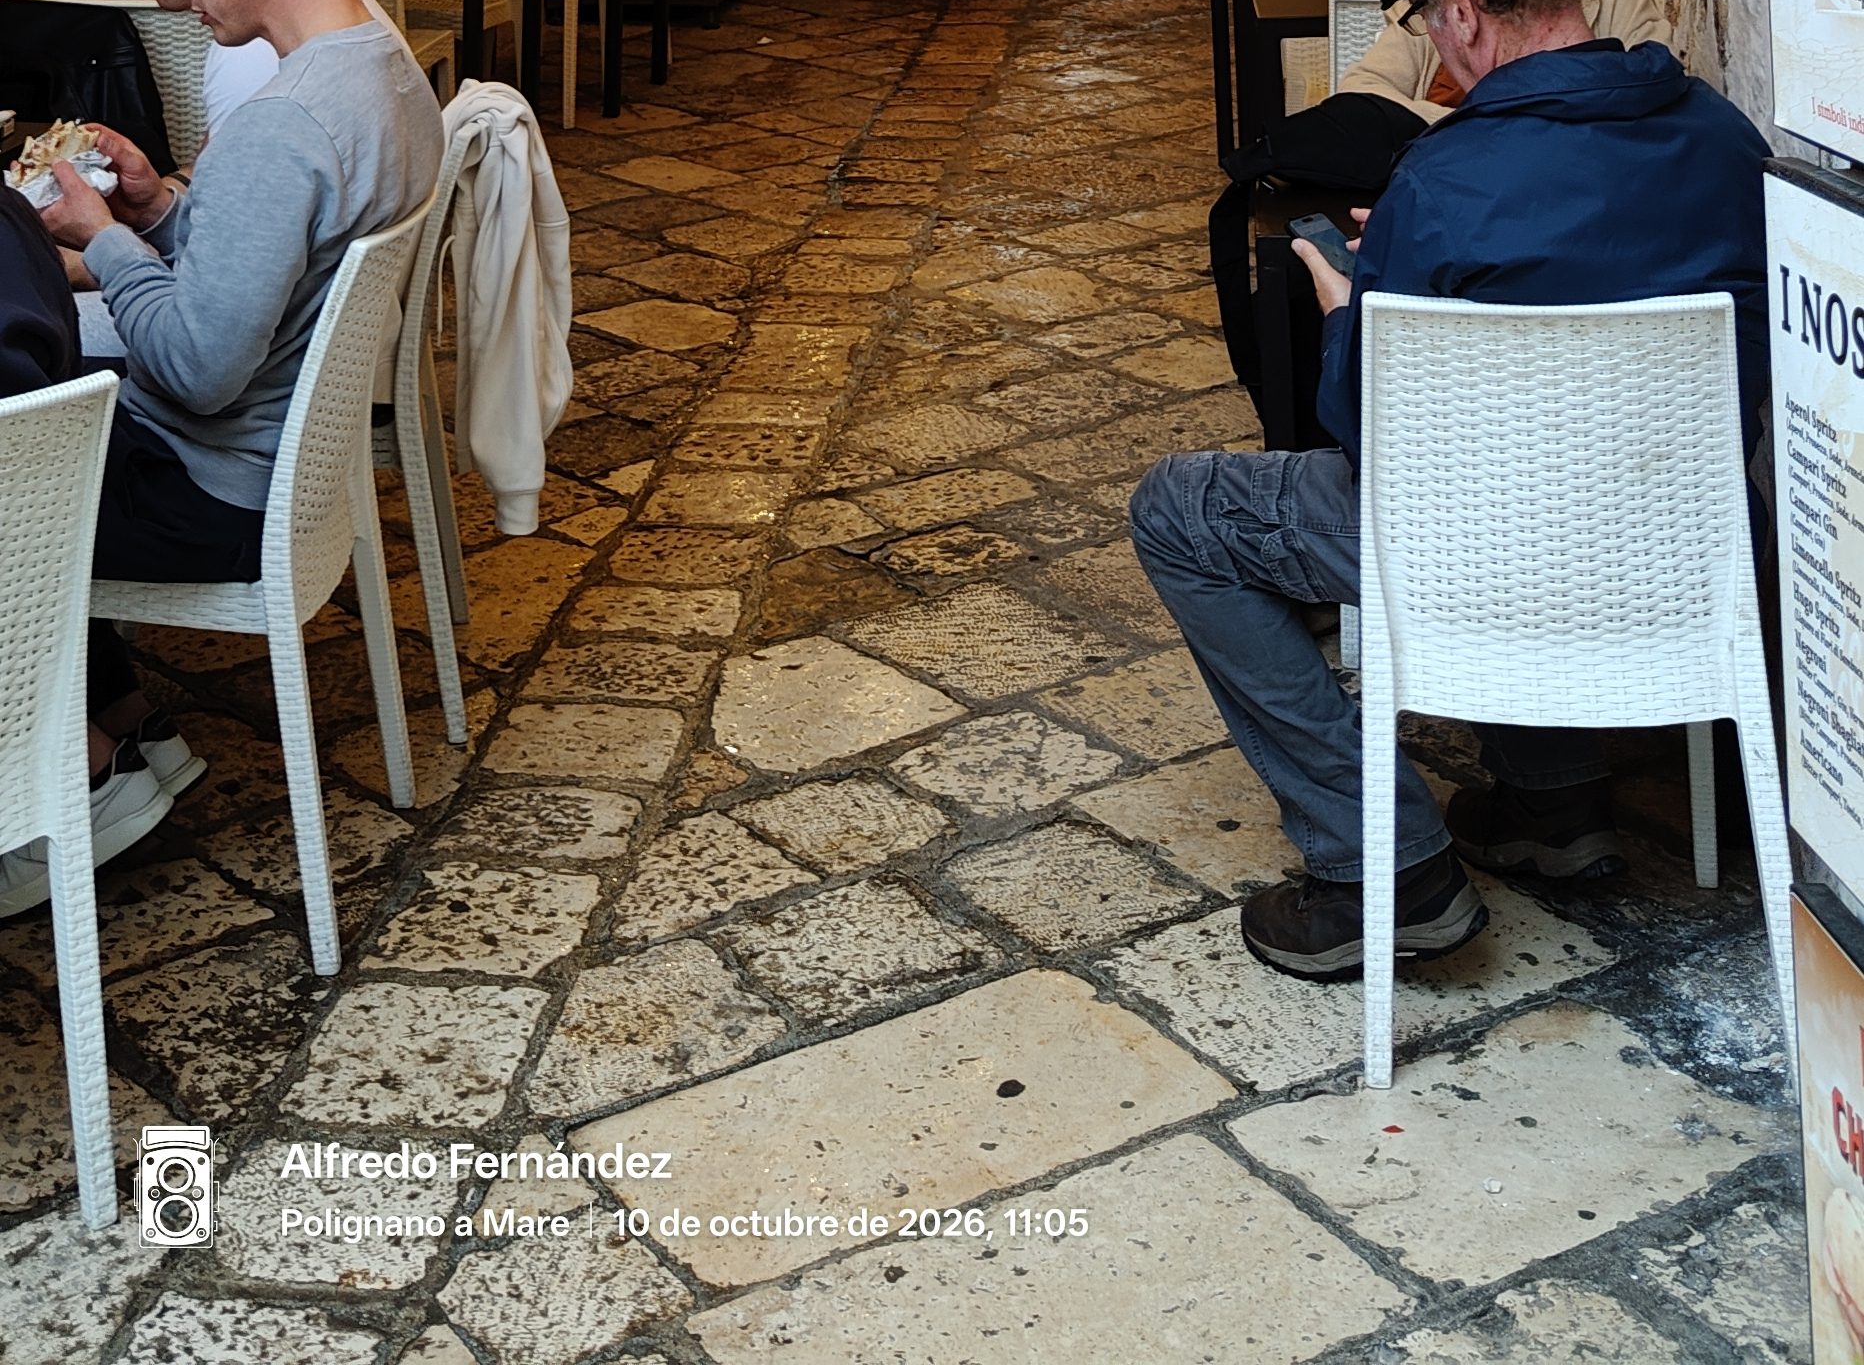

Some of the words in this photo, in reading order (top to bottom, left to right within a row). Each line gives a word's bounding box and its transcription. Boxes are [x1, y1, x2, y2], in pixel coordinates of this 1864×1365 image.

[1817, 100, 1848, 128] simboli
[1779, 263, 1791, 335] I
[1785, 391, 1811, 425] Aperol
[1812, 410, 1838, 443] Spritz
[1787, 439, 1820, 478] Campari
[1821, 464, 1847, 499] Spritz
[1789, 486, 1821, 527] Campari
[1823, 513, 1838, 541] Gin
[1791, 532, 1834, 585] Limoncello
[1835, 571, 1862, 609] Spritz
[1793, 580, 1814, 617] Hugo
[1815, 600, 1841, 639] Spritz
[1795, 628, 1827, 675] Negroni
[1797, 676, 1830, 725] Negroni
[1800, 728, 1844, 786] Americano
